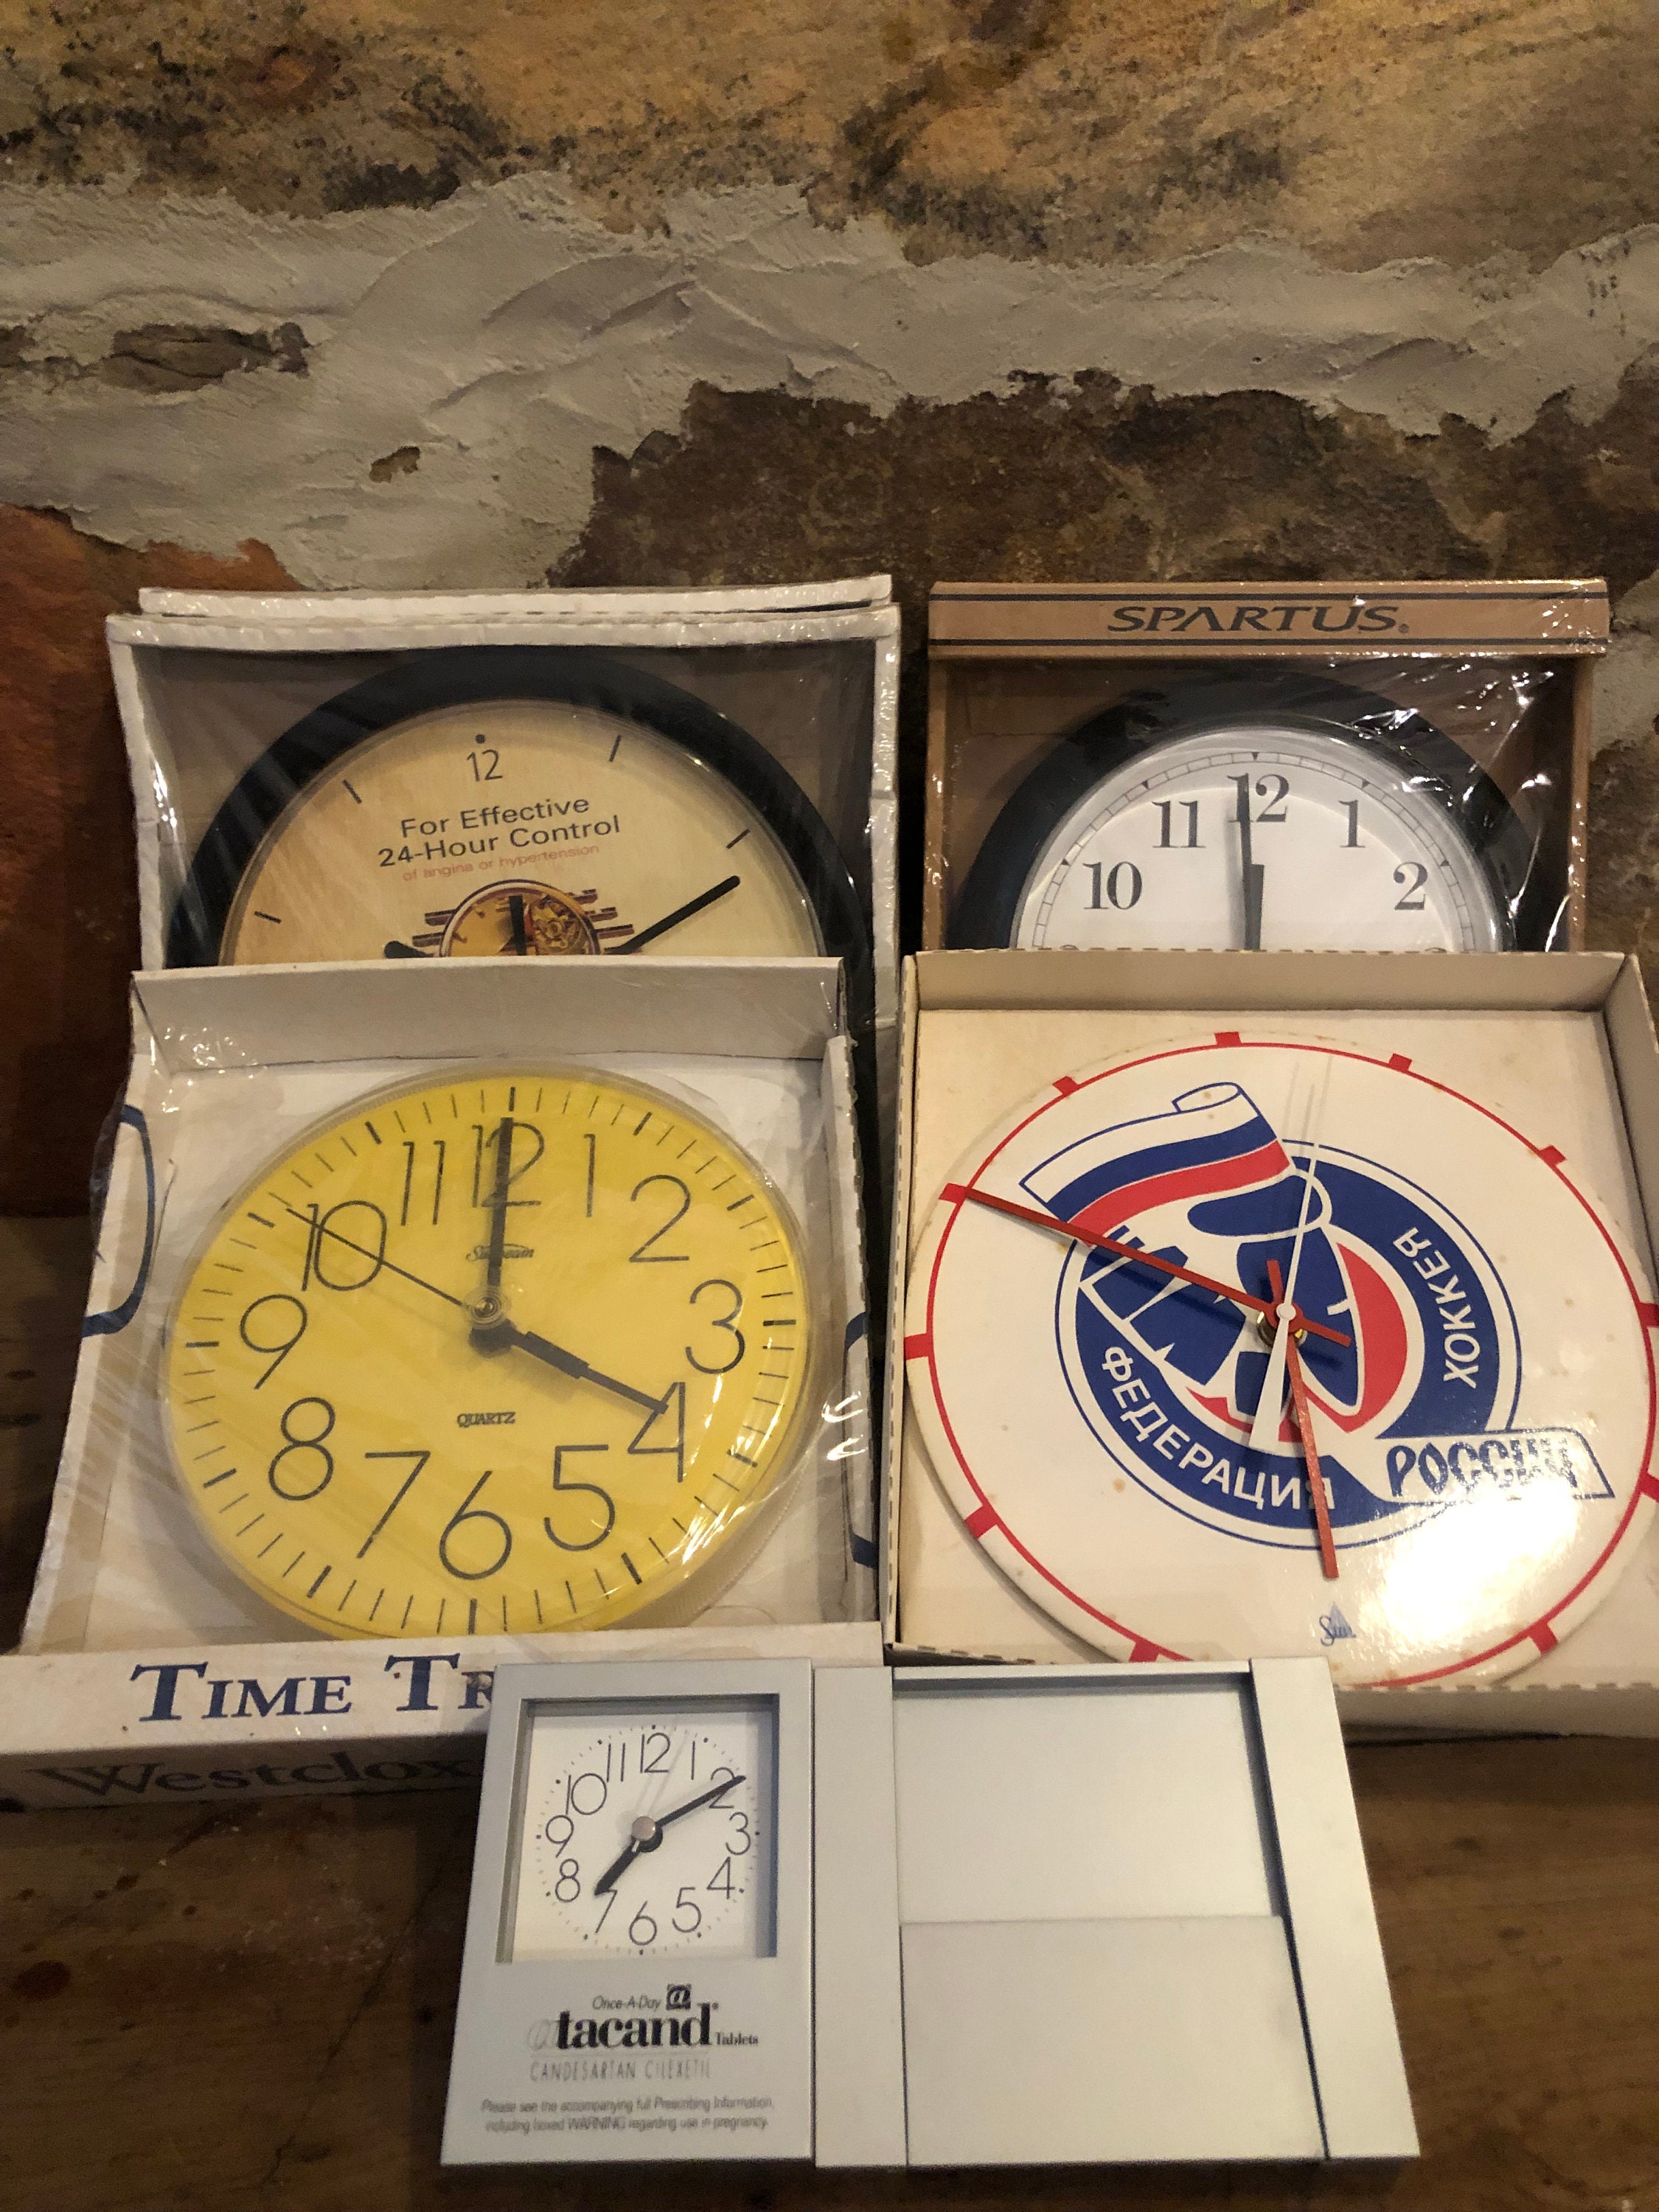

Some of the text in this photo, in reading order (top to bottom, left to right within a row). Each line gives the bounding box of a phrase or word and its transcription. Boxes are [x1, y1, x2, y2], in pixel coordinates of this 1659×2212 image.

[466, 748, 504, 783] 12
[400, 799, 590, 838] For Effective
[1226, 773, 1290, 824] 12
[378, 814, 621, 868] 24-Hour Control
[1151, 799, 1207, 849] 11
[1338, 799, 1366, 849] 1
[403, 844, 600, 883] of angina or hypertension
[1082, 860, 1144, 912] 10
[1392, 860, 1427, 912] 2
[400, 1141, 446, 1226] 11
[471, 1121, 546, 1208] 12
[582, 1133, 597, 1218] 1
[629, 1173, 693, 1264] 2
[298, 1200, 389, 1292] 10
[685, 1279, 747, 1374] 3
[1392, 1226, 1481, 1390] ХОККЕЯ
[240, 1293, 308, 1390] 9
[456, 1411, 515, 1427] QUARTZ
[627, 1381, 686, 1483] 4
[268, 1396, 338, 1502] 8
[357, 1450, 431, 1559] 7
[543, 1444, 616, 1551] 5
[439, 1470, 513, 1581] 6
[130, 1660, 353, 1722] TIME
[26, 1750, 478, 1798] Westclox
[606, 1742, 626, 1783] 11
[640, 1733, 671, 1773] 12
[689, 1740, 697, 1781] 1
[565, 1773, 608, 1815] 10
[709, 1767, 737, 1809] 2
[545, 1815, 574, 1858] 9
[726, 1812, 751, 1855] 3
[555, 1859, 581, 1902] 8
[706, 1856, 736, 1900] 4
[594, 1889, 619, 1934] 7
[629, 1900, 658, 1946] 6
[672, 1888, 702, 1933] 5
[715, 2031, 759, 2046] Tablets
